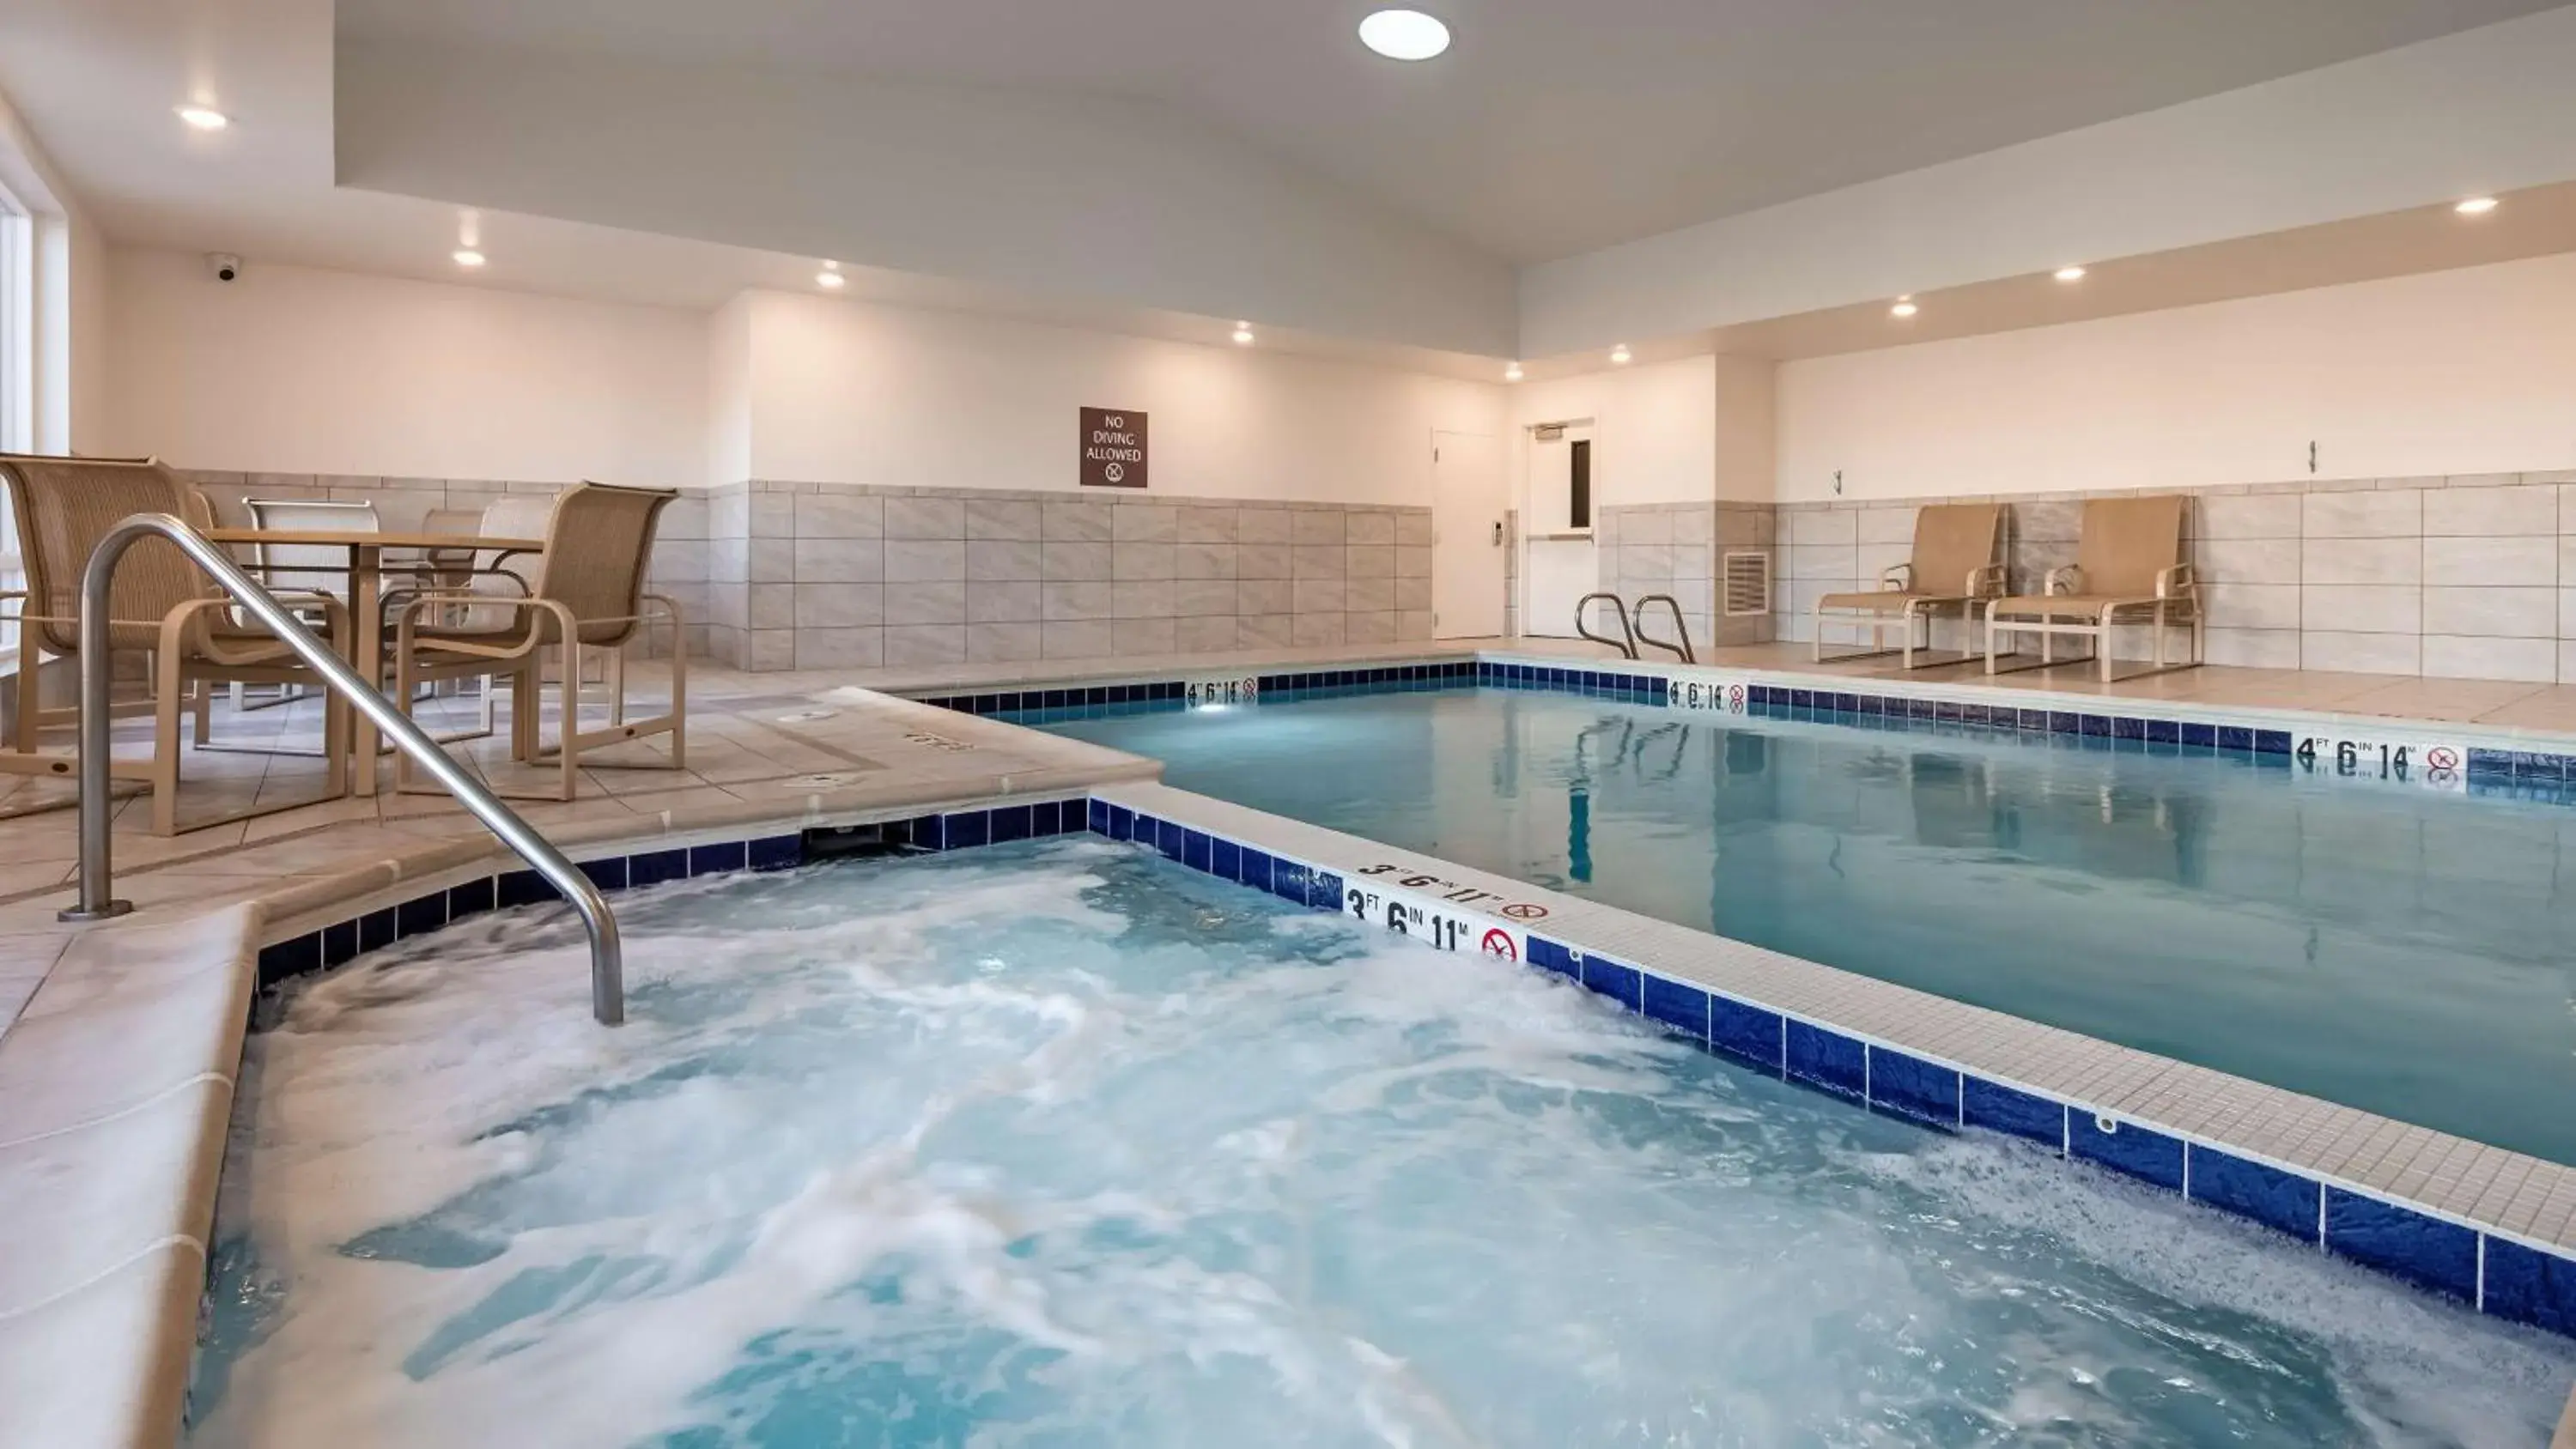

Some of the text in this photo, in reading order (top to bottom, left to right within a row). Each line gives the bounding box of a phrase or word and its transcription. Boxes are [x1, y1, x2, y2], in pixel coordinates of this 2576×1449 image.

[1105, 415, 1124, 428] NO
[1093, 430, 1134, 446] DIVING
[1086, 447, 1141, 462] ALLOWED
